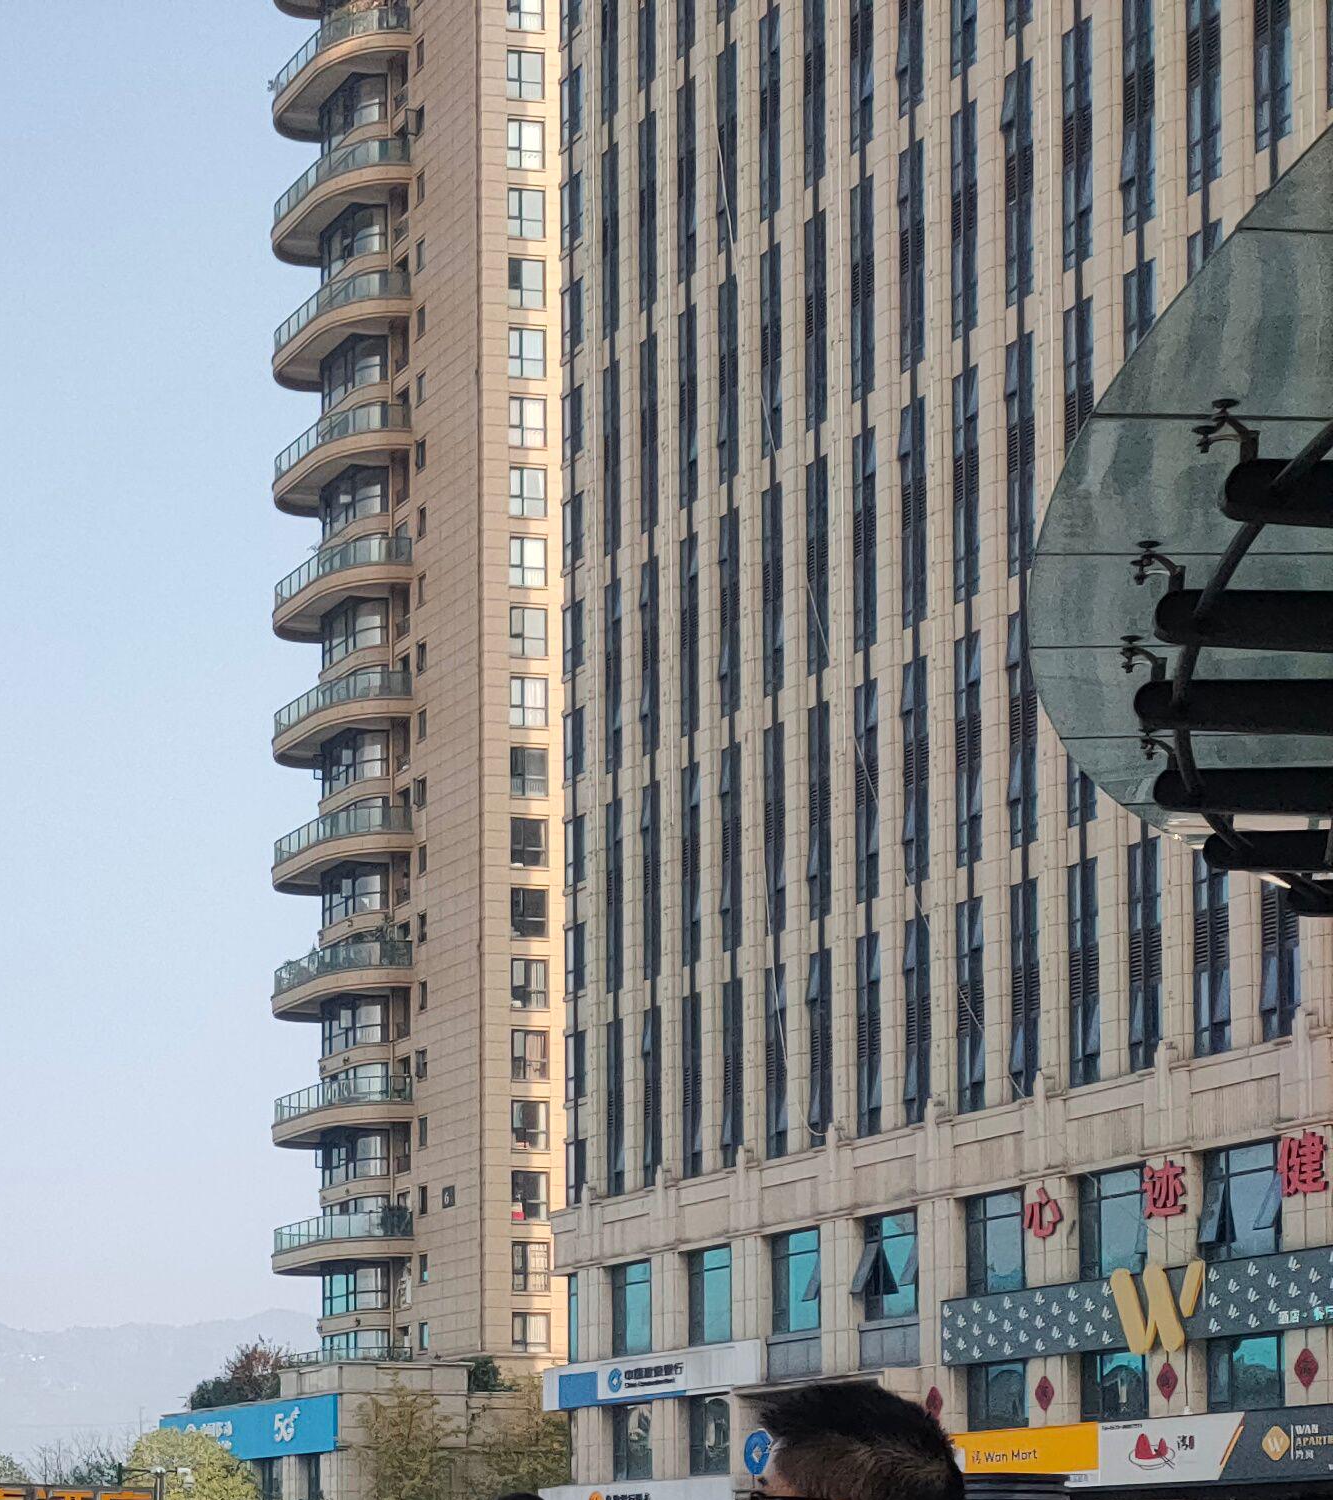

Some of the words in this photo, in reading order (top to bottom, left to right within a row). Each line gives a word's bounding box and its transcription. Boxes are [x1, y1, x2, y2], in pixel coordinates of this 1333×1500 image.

[1295, 1423, 1319, 1436] WAN
[984, 1451, 1008, 1463] Wan
[1012, 1448, 1038, 1461] Mart
